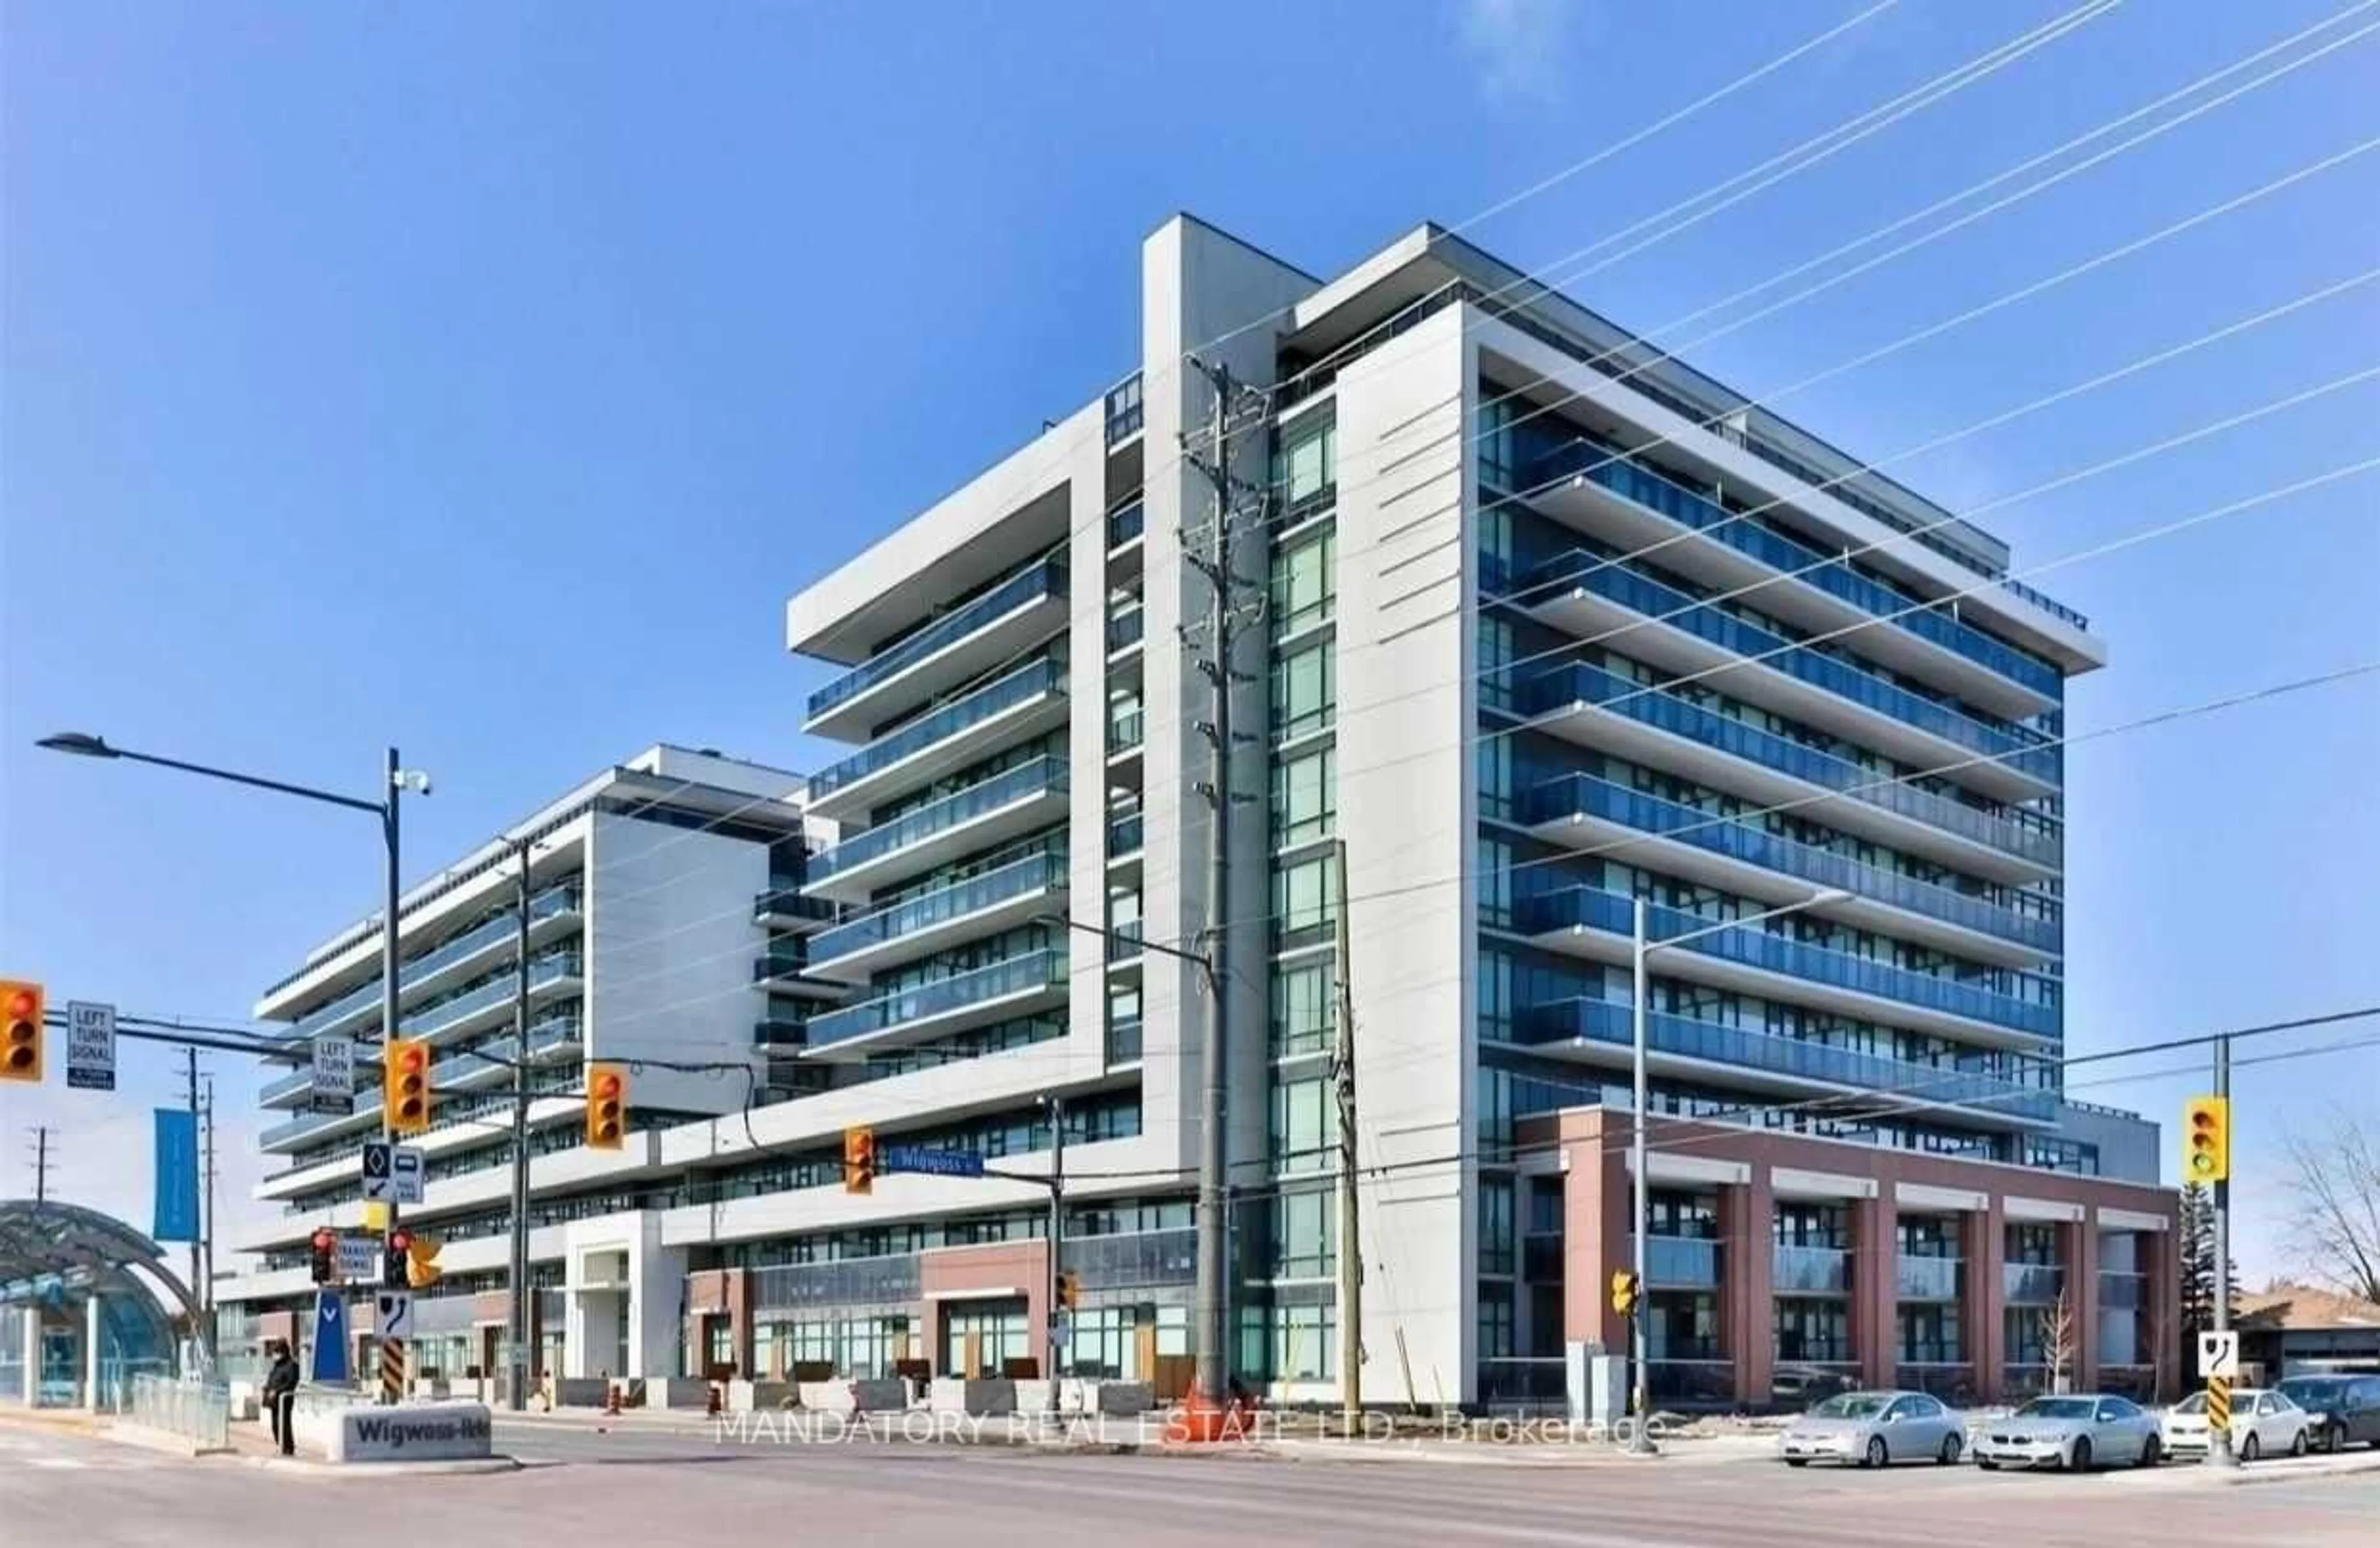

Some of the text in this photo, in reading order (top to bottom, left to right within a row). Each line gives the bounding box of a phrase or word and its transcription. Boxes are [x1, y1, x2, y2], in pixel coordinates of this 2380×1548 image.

[75, 1009, 105, 1026] LEFT
[75, 1026, 108, 1044] TURN
[321, 1042, 346, 1057] LEFT
